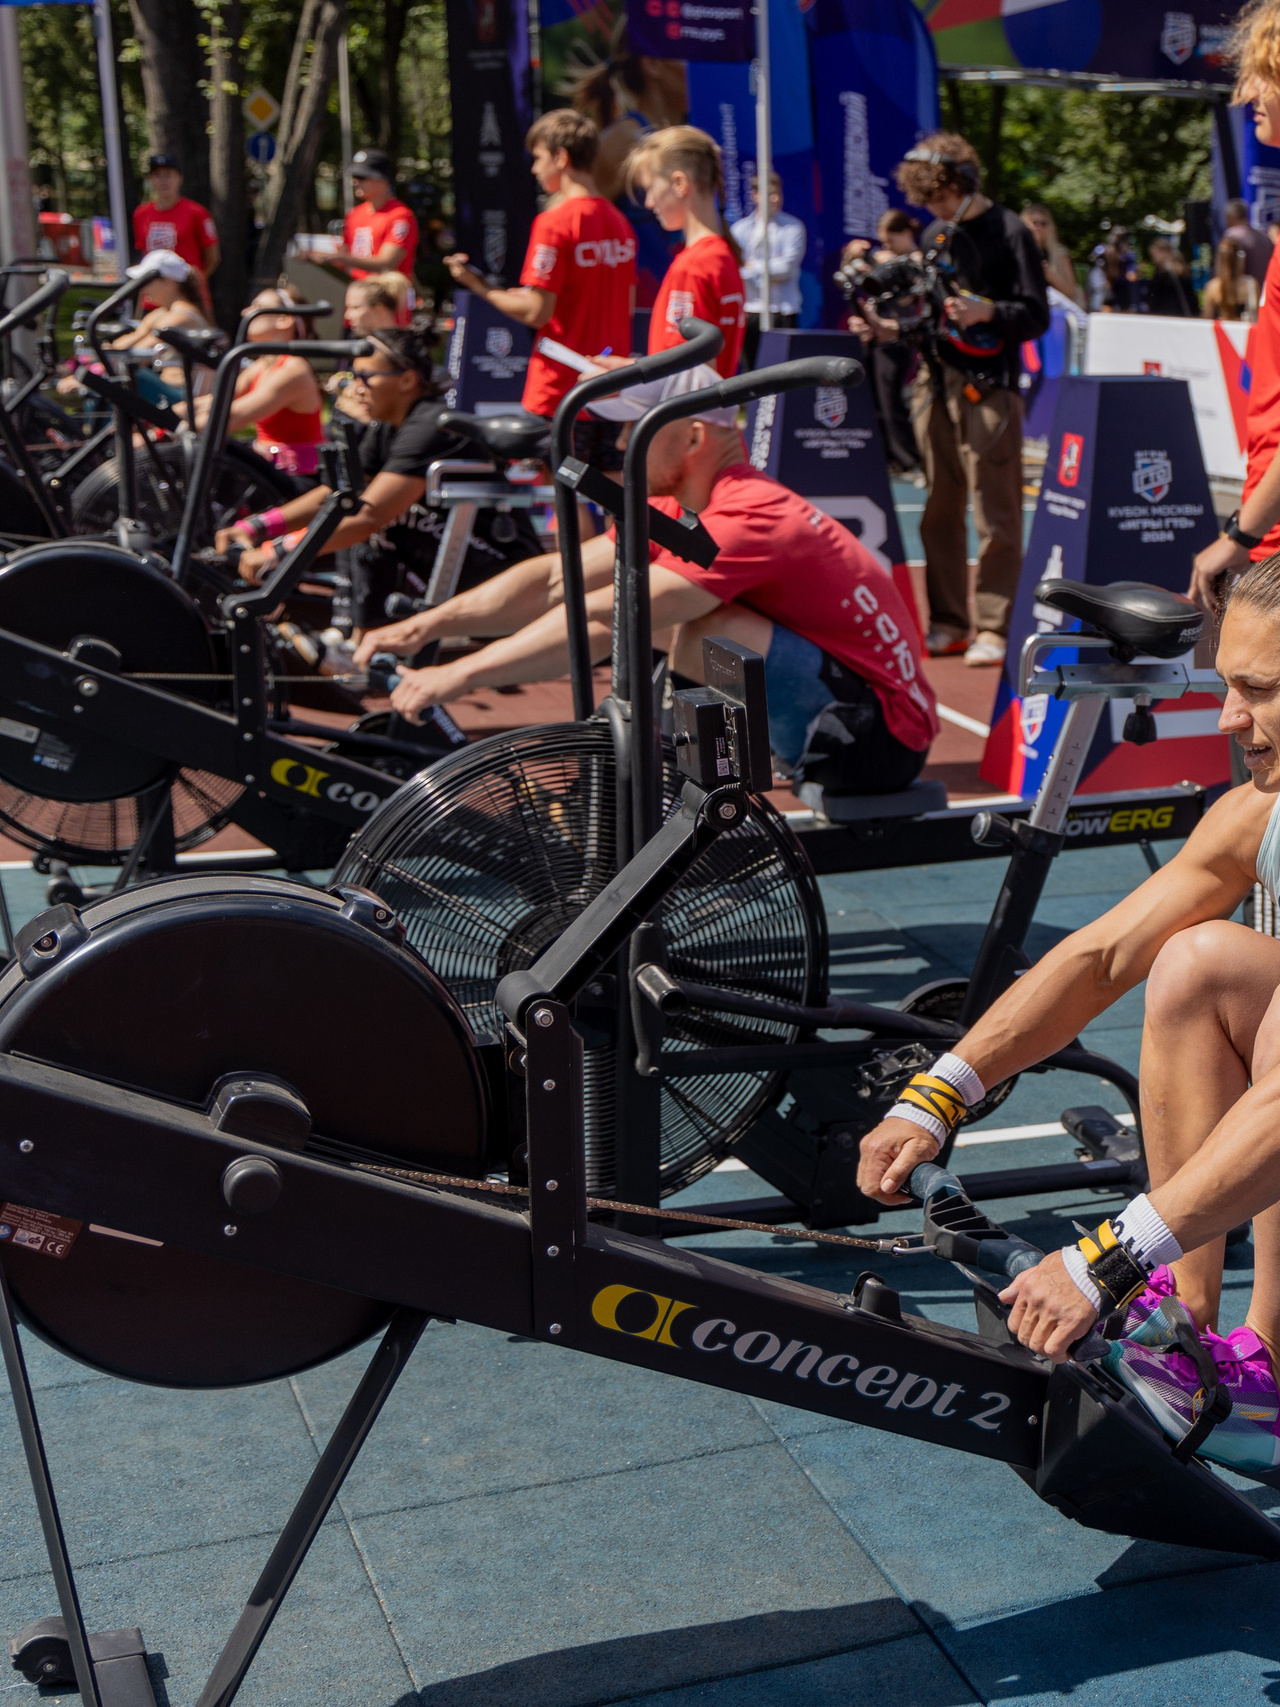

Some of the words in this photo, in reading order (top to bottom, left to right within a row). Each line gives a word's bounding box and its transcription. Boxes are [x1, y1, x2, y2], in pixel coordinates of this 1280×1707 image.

[1107, 506, 1150, 519] КУБОК
[1151, 504, 1204, 517] МОСКВЫ
[1064, 806, 1175, 837] owERG
[46, 1241, 65, 1255] CE
[692, 1318, 966, 1418] concept
[967, 1391, 1011, 1433] 2
